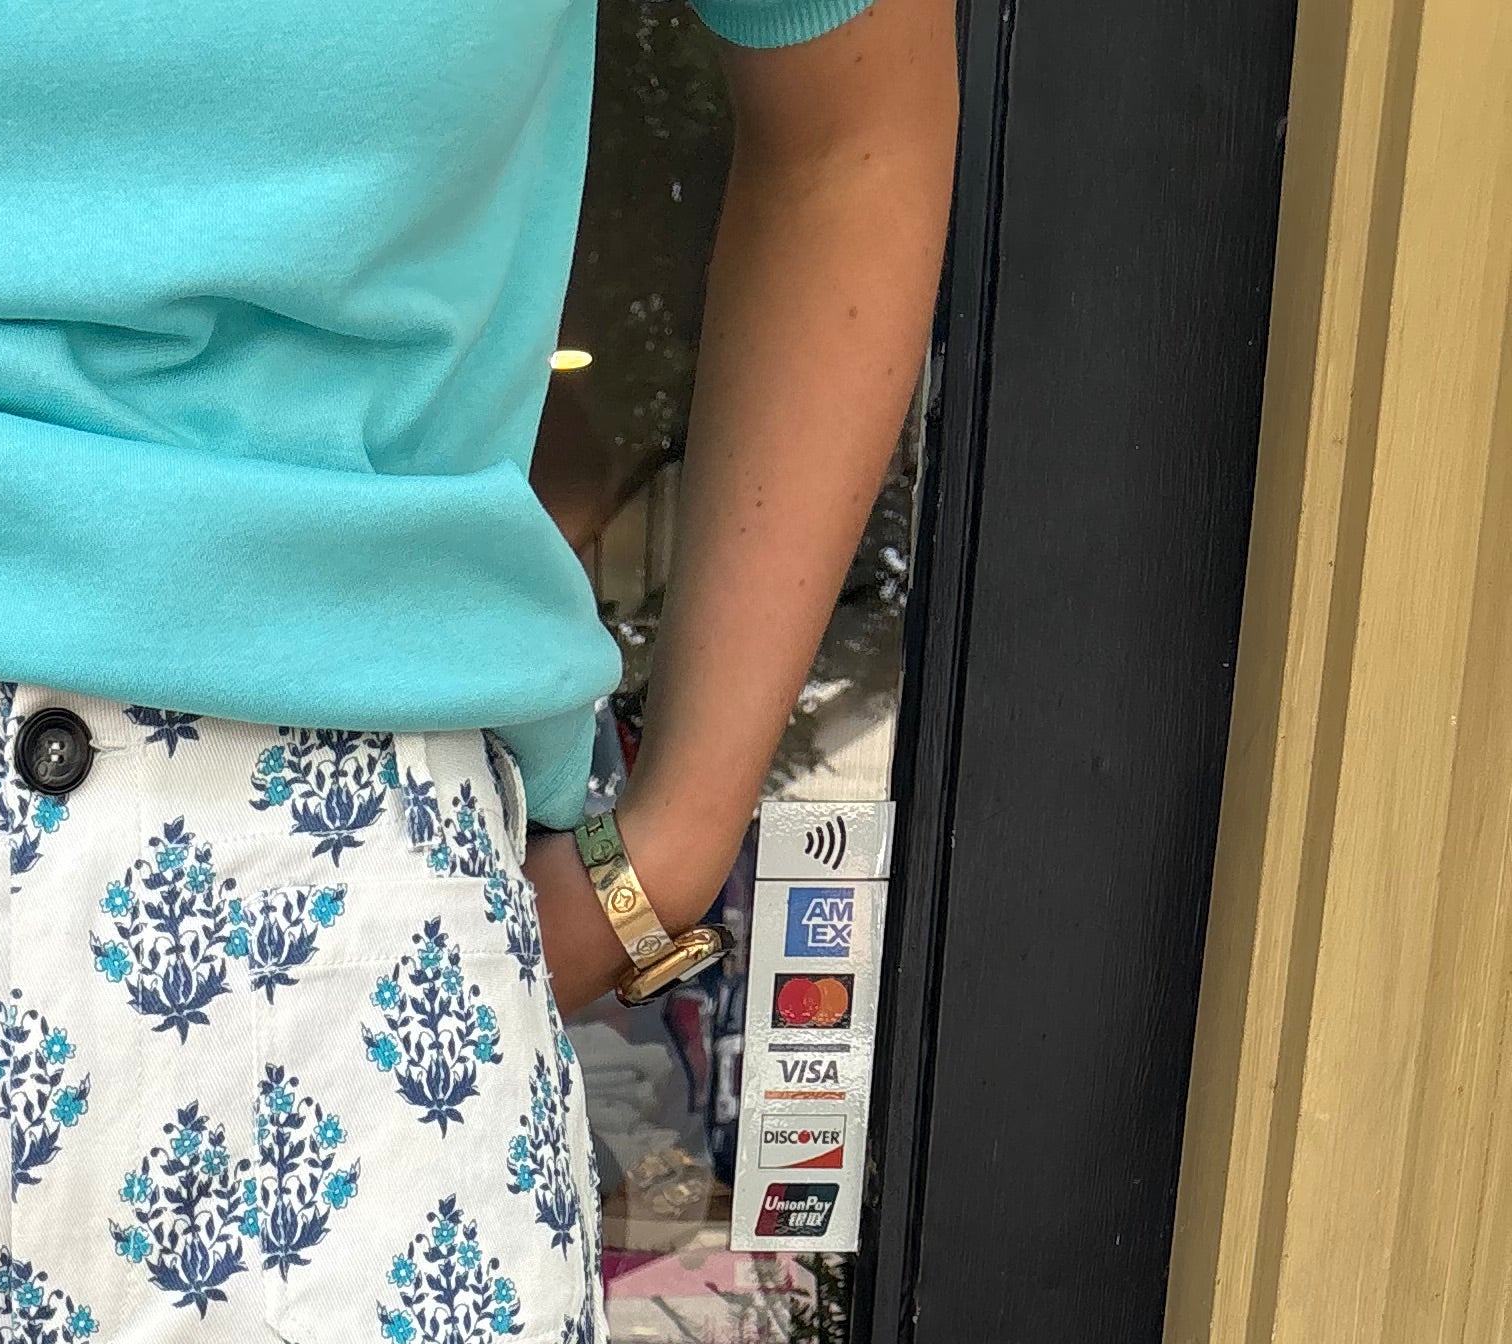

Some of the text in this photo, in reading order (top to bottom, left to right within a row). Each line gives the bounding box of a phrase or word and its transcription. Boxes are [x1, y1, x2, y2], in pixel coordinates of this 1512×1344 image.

[802, 898, 854, 923] AM
[809, 923, 852, 946] EX
[776, 1059, 840, 1084] VISA
[763, 1128, 840, 1145] DISCOVER
[764, 1195, 833, 1218] UnionPay
